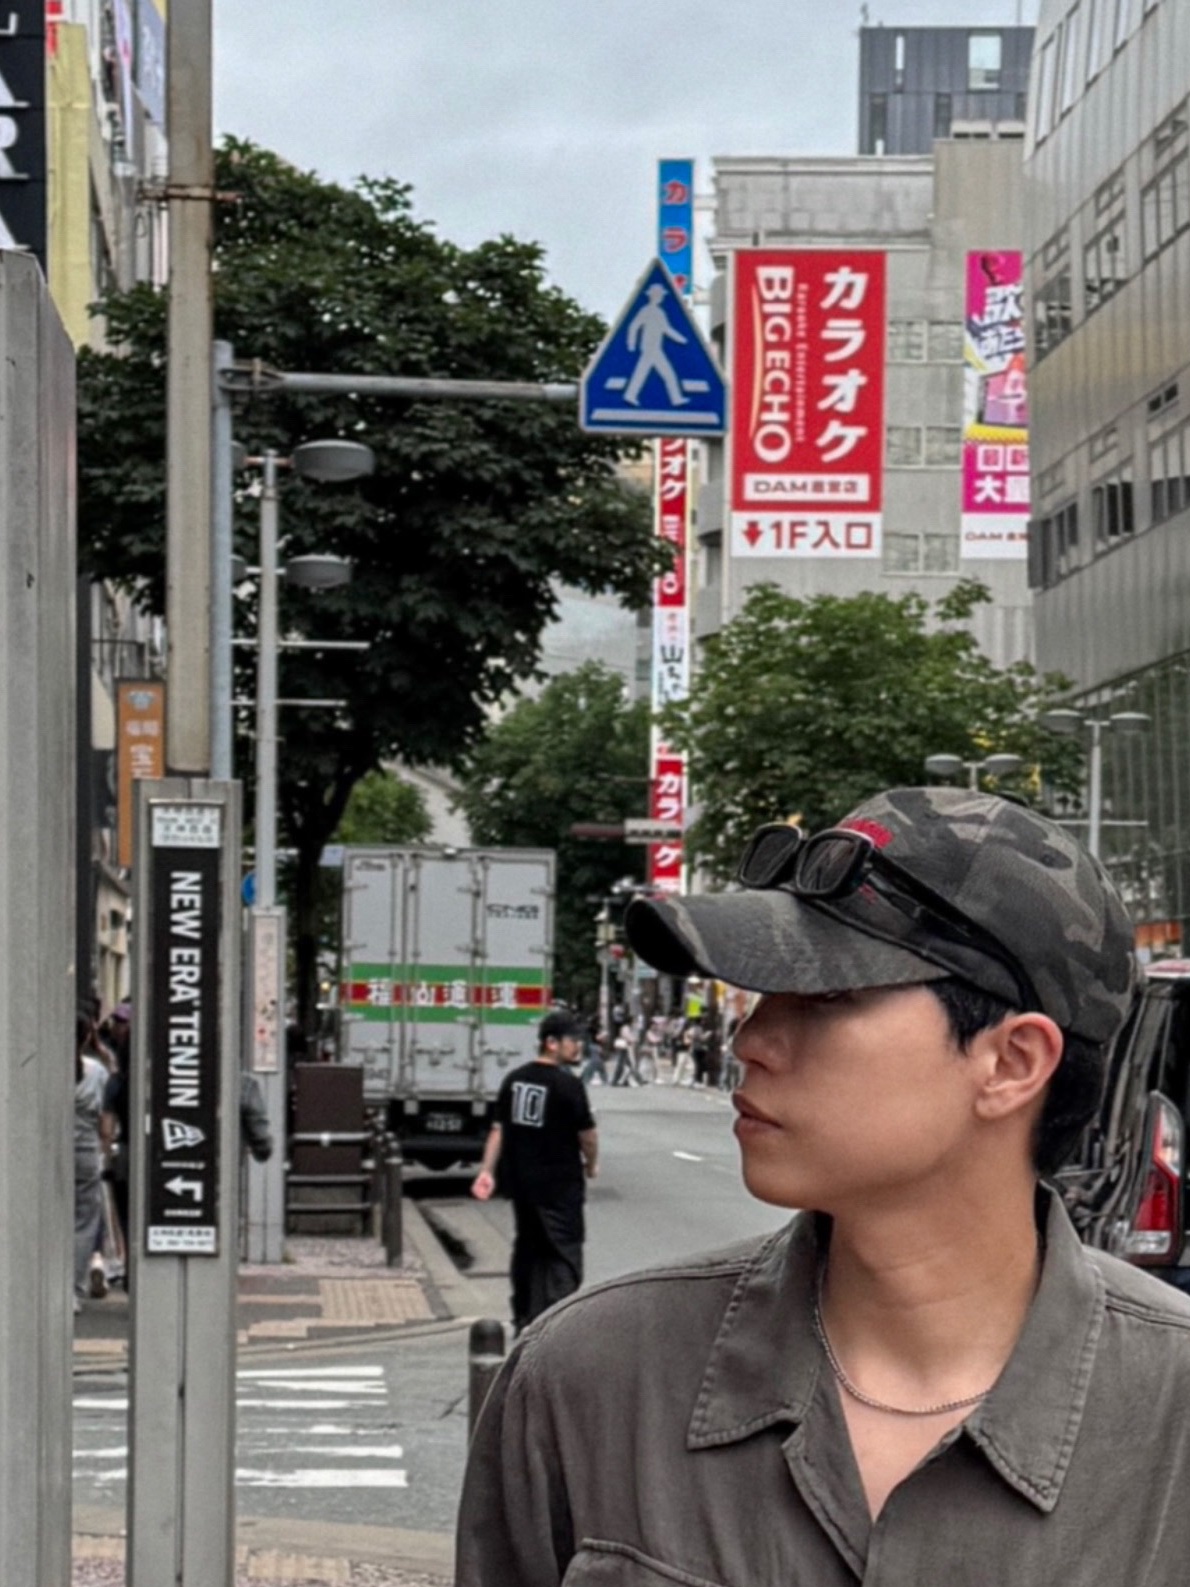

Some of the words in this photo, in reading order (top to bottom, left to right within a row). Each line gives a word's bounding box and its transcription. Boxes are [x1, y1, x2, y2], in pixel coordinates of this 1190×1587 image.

[755, 266, 795, 342] BIG
[815, 266, 869, 463] カラオケ
[753, 351, 793, 463] ECHO
[770, 520, 873, 550] 1F入口
[656, 772, 681, 868] カラケ
[169, 871, 202, 939] NEW
[169, 948, 201, 1003] ERA
[168, 1011, 201, 1107] TENJIN
[512, 1081, 547, 1128] 10
